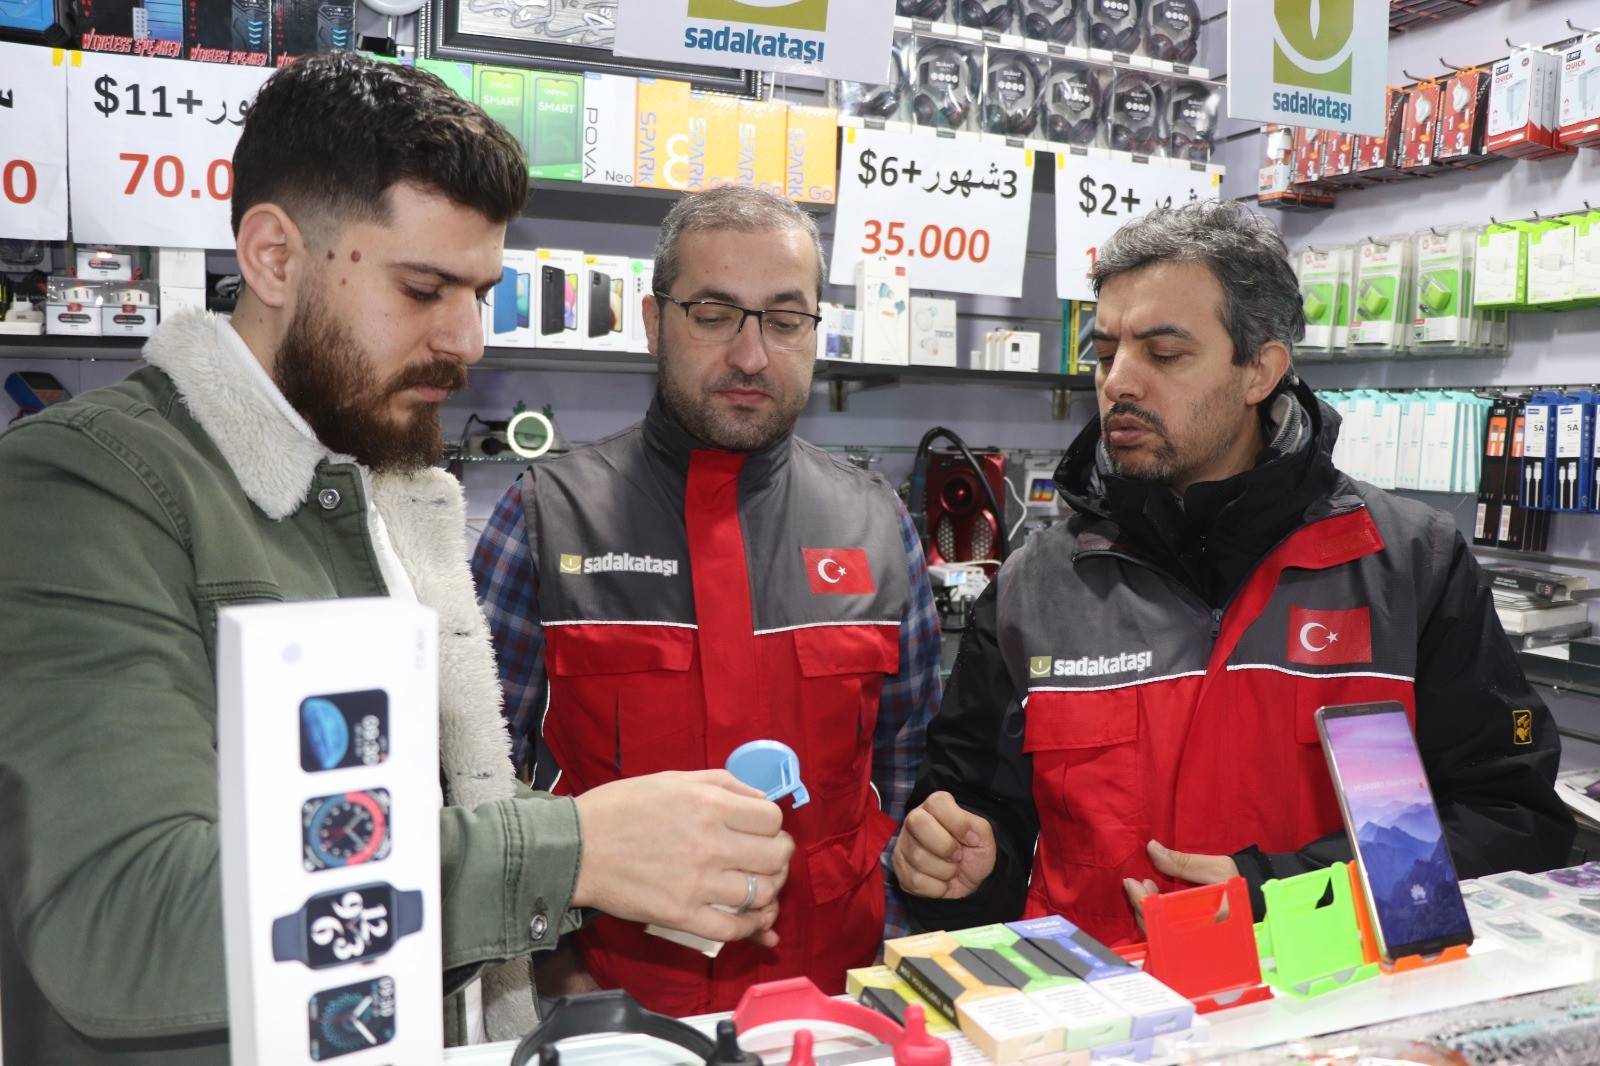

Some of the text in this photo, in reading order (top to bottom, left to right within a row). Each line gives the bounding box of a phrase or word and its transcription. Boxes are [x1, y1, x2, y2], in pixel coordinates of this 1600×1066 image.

[81, 27, 133, 53] WIRELESS
[684, 26, 825, 65] sadakataşı
[1566, 59, 1587, 70] QUICK
[482, 94, 520, 108] SMART
[537, 101, 577, 115] SMART
[1272, 90, 1352, 123] sadakataşı
[584, 107, 599, 179] POVA
[605, 169, 633, 184] Neo
[808, 185, 834, 201] Go
[861, 219, 991, 264] 35.000
[584, 552, 679, 577] sadakataşı
[1053, 650, 1153, 677] sadakataşı
